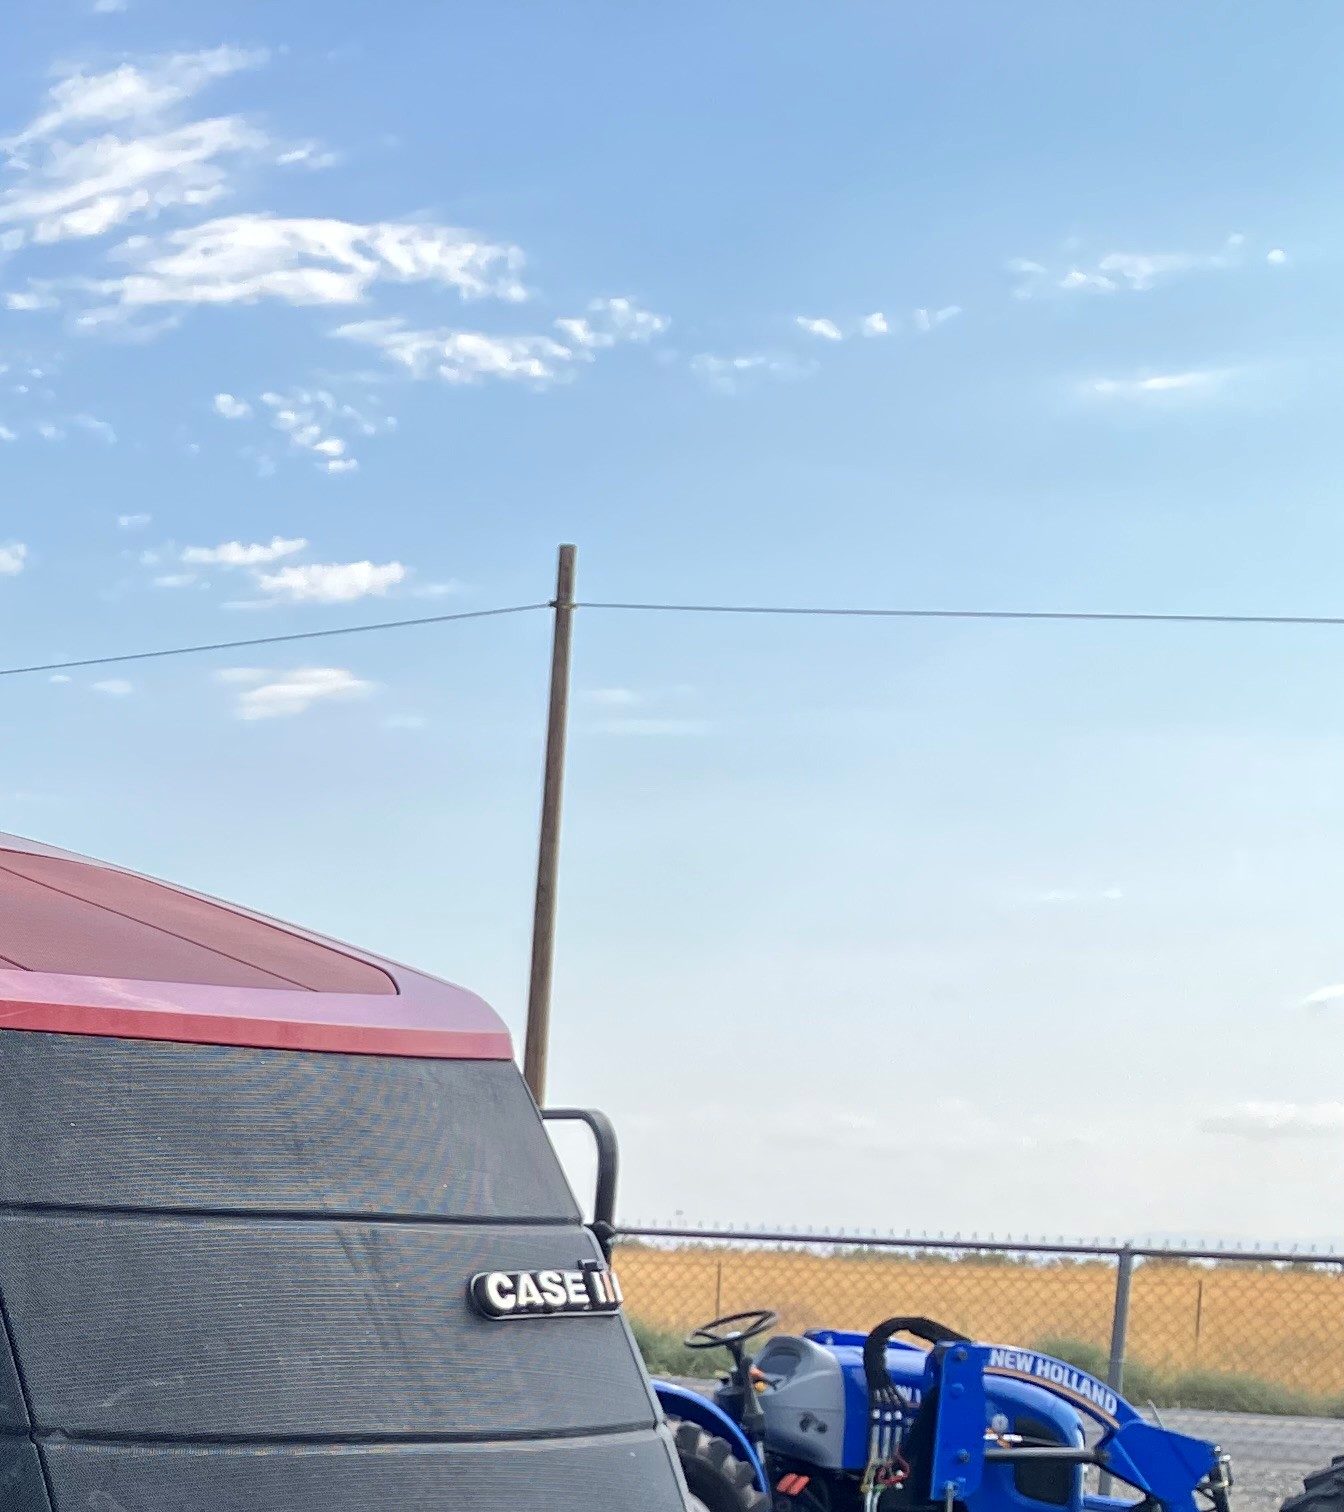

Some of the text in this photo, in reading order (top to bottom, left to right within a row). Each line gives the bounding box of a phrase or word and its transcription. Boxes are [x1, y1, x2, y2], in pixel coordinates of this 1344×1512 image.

[486, 1271, 589, 1310] CASE
[990, 1349, 1118, 1416] NEW HOLLAND
